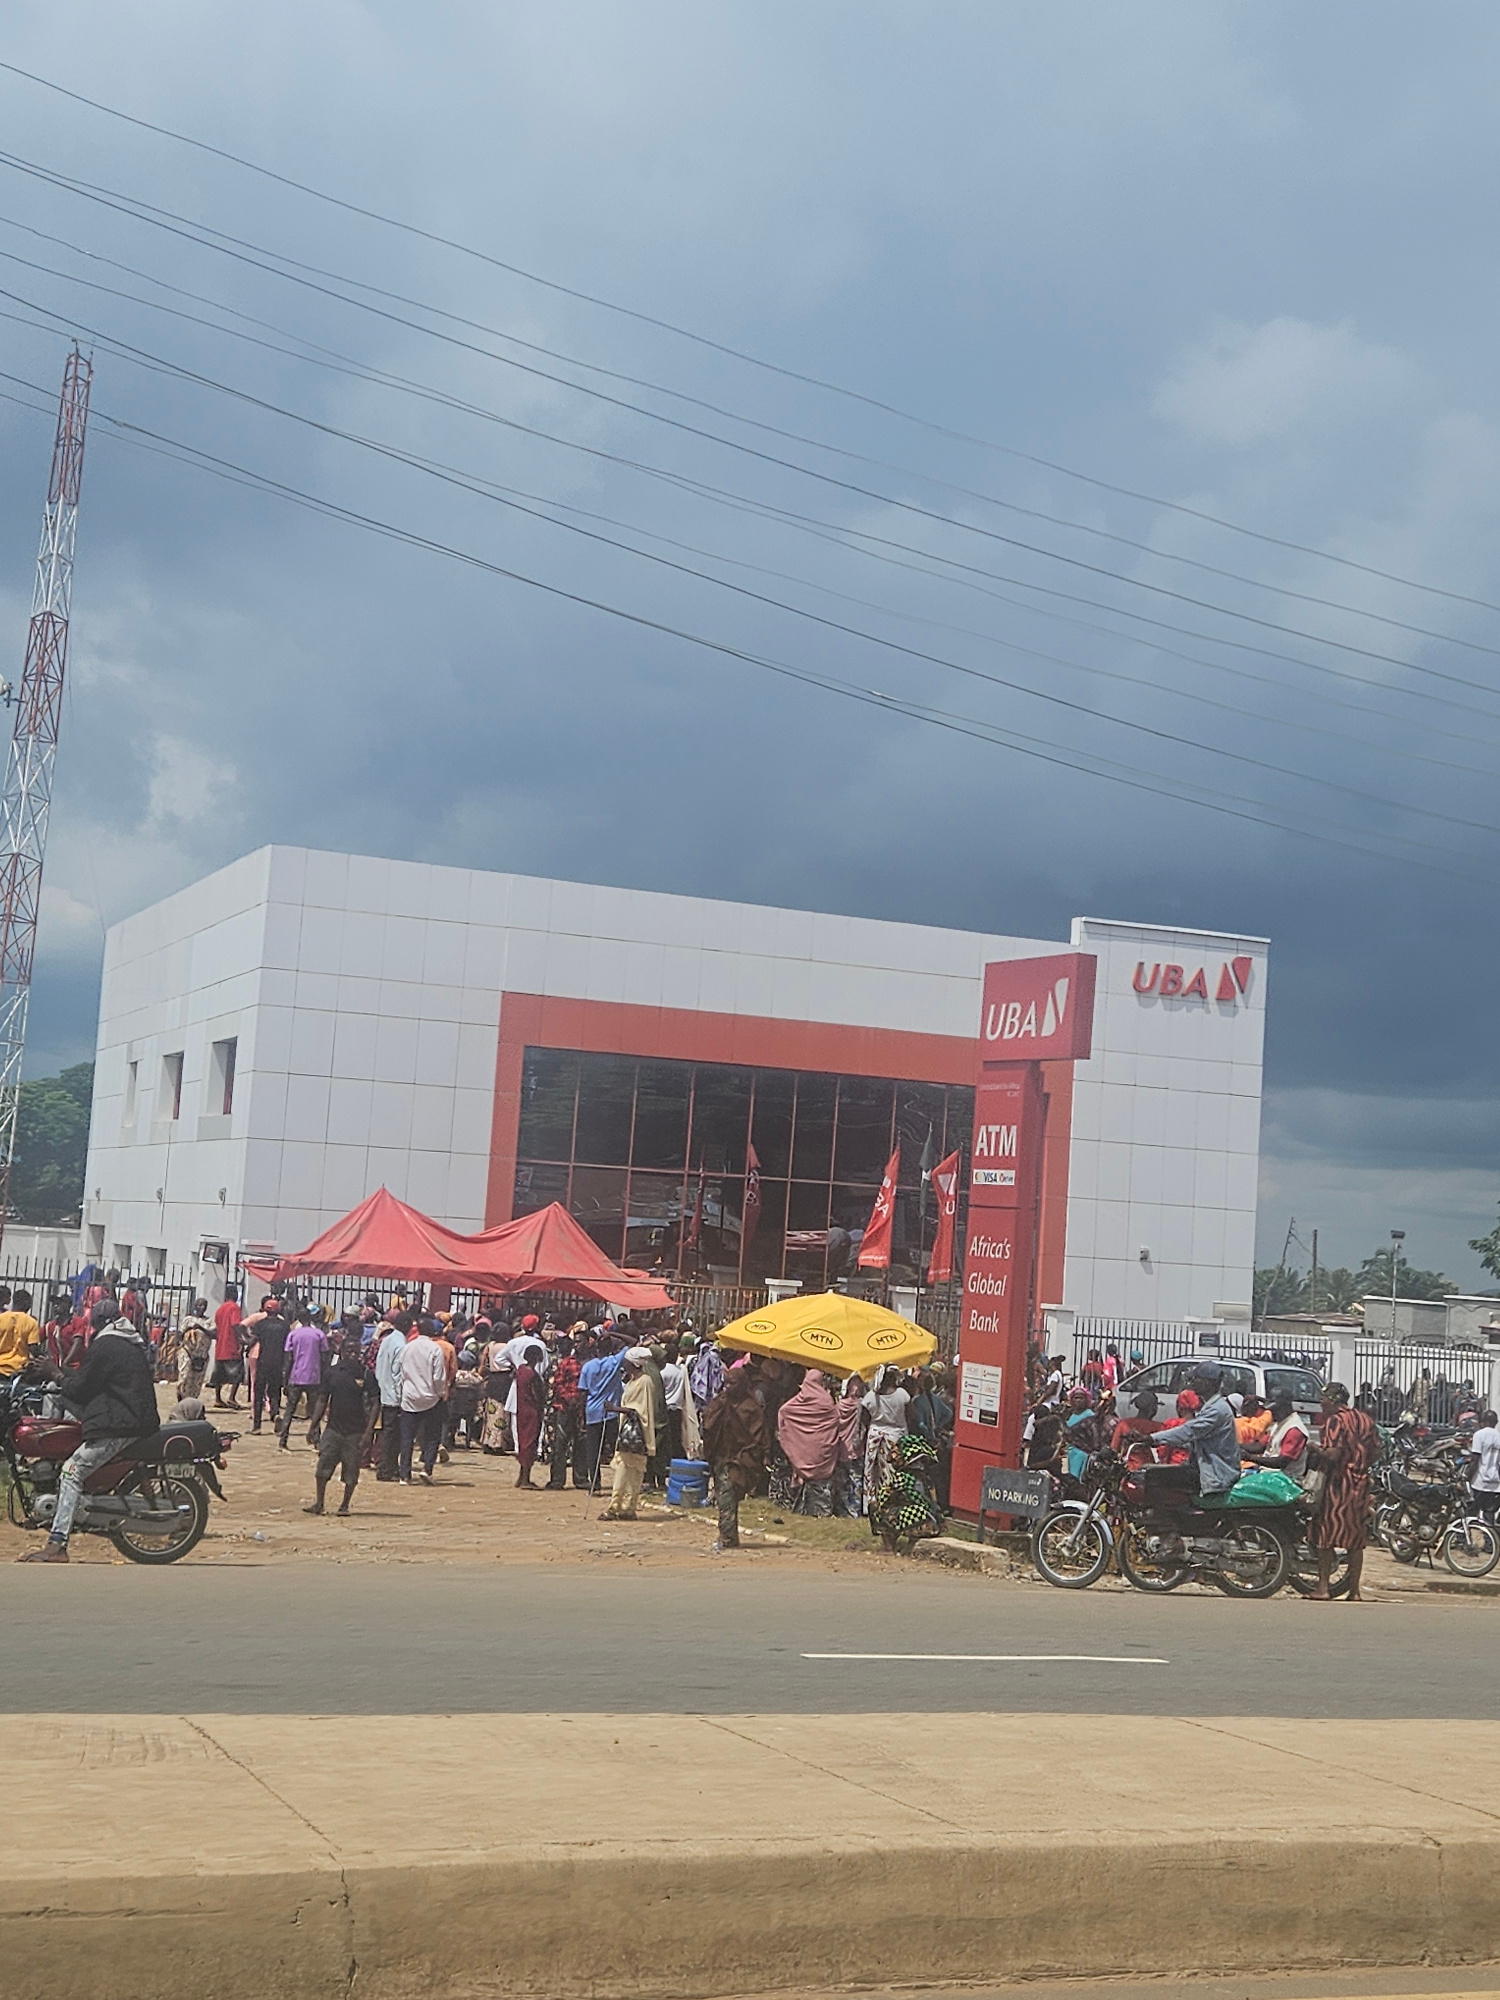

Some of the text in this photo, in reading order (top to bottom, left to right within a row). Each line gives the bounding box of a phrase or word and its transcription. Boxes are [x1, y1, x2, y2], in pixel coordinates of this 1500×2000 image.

[1132, 961, 1208, 998] UBA
[986, 1000, 1037, 1041] UBA
[975, 1124, 1018, 1157] ATM
[983, 1171, 998, 1183] VISA
[969, 1235, 1011, 1260] Africa's
[968, 1272, 1008, 1297] Global
[969, 1309, 1000, 1334] Bank
[810, 1333, 834, 1345] MTN
[876, 1334, 898, 1345] MTN
[988, 1487, 1002, 1501] NO
